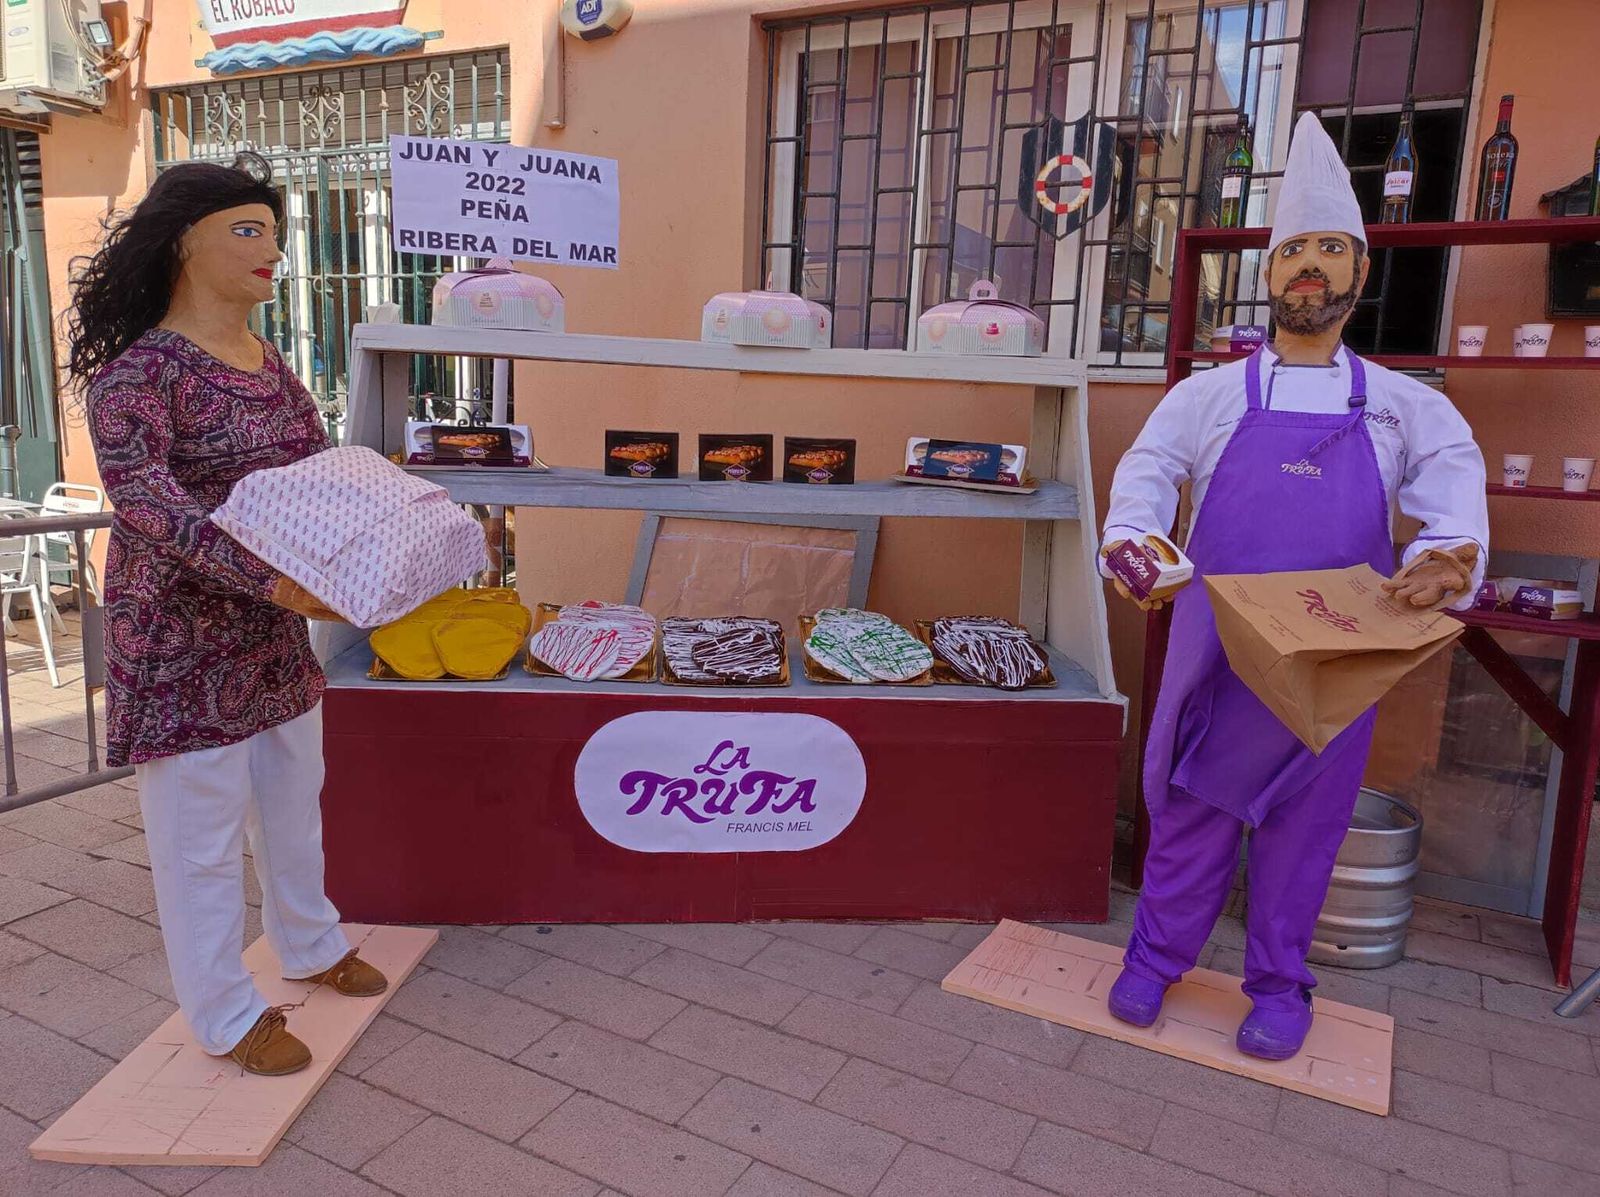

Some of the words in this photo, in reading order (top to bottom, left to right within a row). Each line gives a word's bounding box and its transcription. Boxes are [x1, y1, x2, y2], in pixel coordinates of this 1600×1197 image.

[211, 0, 229, 23] EL
[581, 0, 597, 14] ADT
[399, 142, 471, 164] JUAN
[482, 149, 500, 167] Y
[520, 154, 601, 184] JUANA
[466, 172, 526, 196] 2022
[461, 198, 529, 223] PEÑA
[400, 229, 497, 254] RIBERA
[513, 238, 558, 259] DEL
[569, 243, 617, 264] MAR
[1364, 411, 1400, 426] TRUFA
[1281, 463, 1322, 476] TRUFA
[693, 739, 751, 776] LA
[619, 770, 818, 824] TRUFA
[726, 822, 784, 834] FRANCIS
[786, 821, 814, 832] MEL
